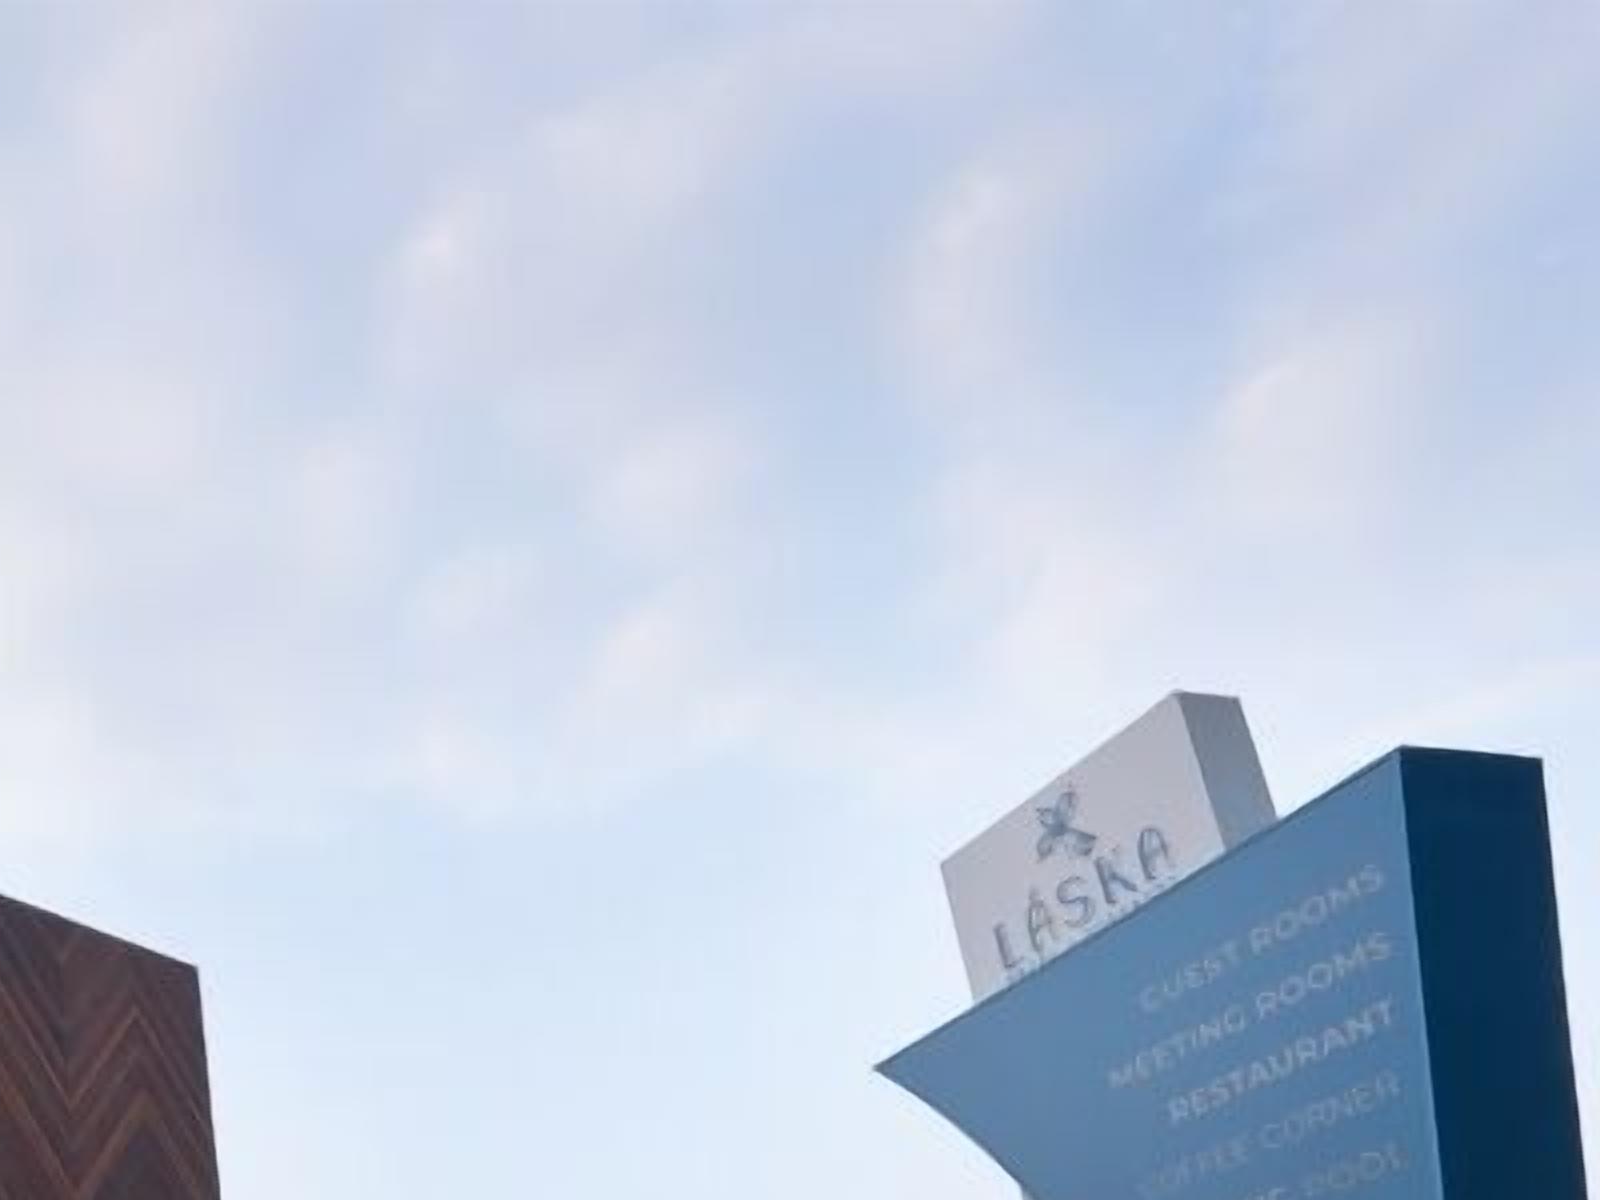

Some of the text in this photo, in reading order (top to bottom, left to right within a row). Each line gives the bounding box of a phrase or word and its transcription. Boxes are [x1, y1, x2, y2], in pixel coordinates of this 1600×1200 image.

[1138, 864, 1386, 1013] GUEST ROOMS
[1106, 932, 1392, 1090] MEETING ROOMS
[1167, 997, 1394, 1126] RESTAURANT
[1260, 1070, 1401, 1149] CORNER
